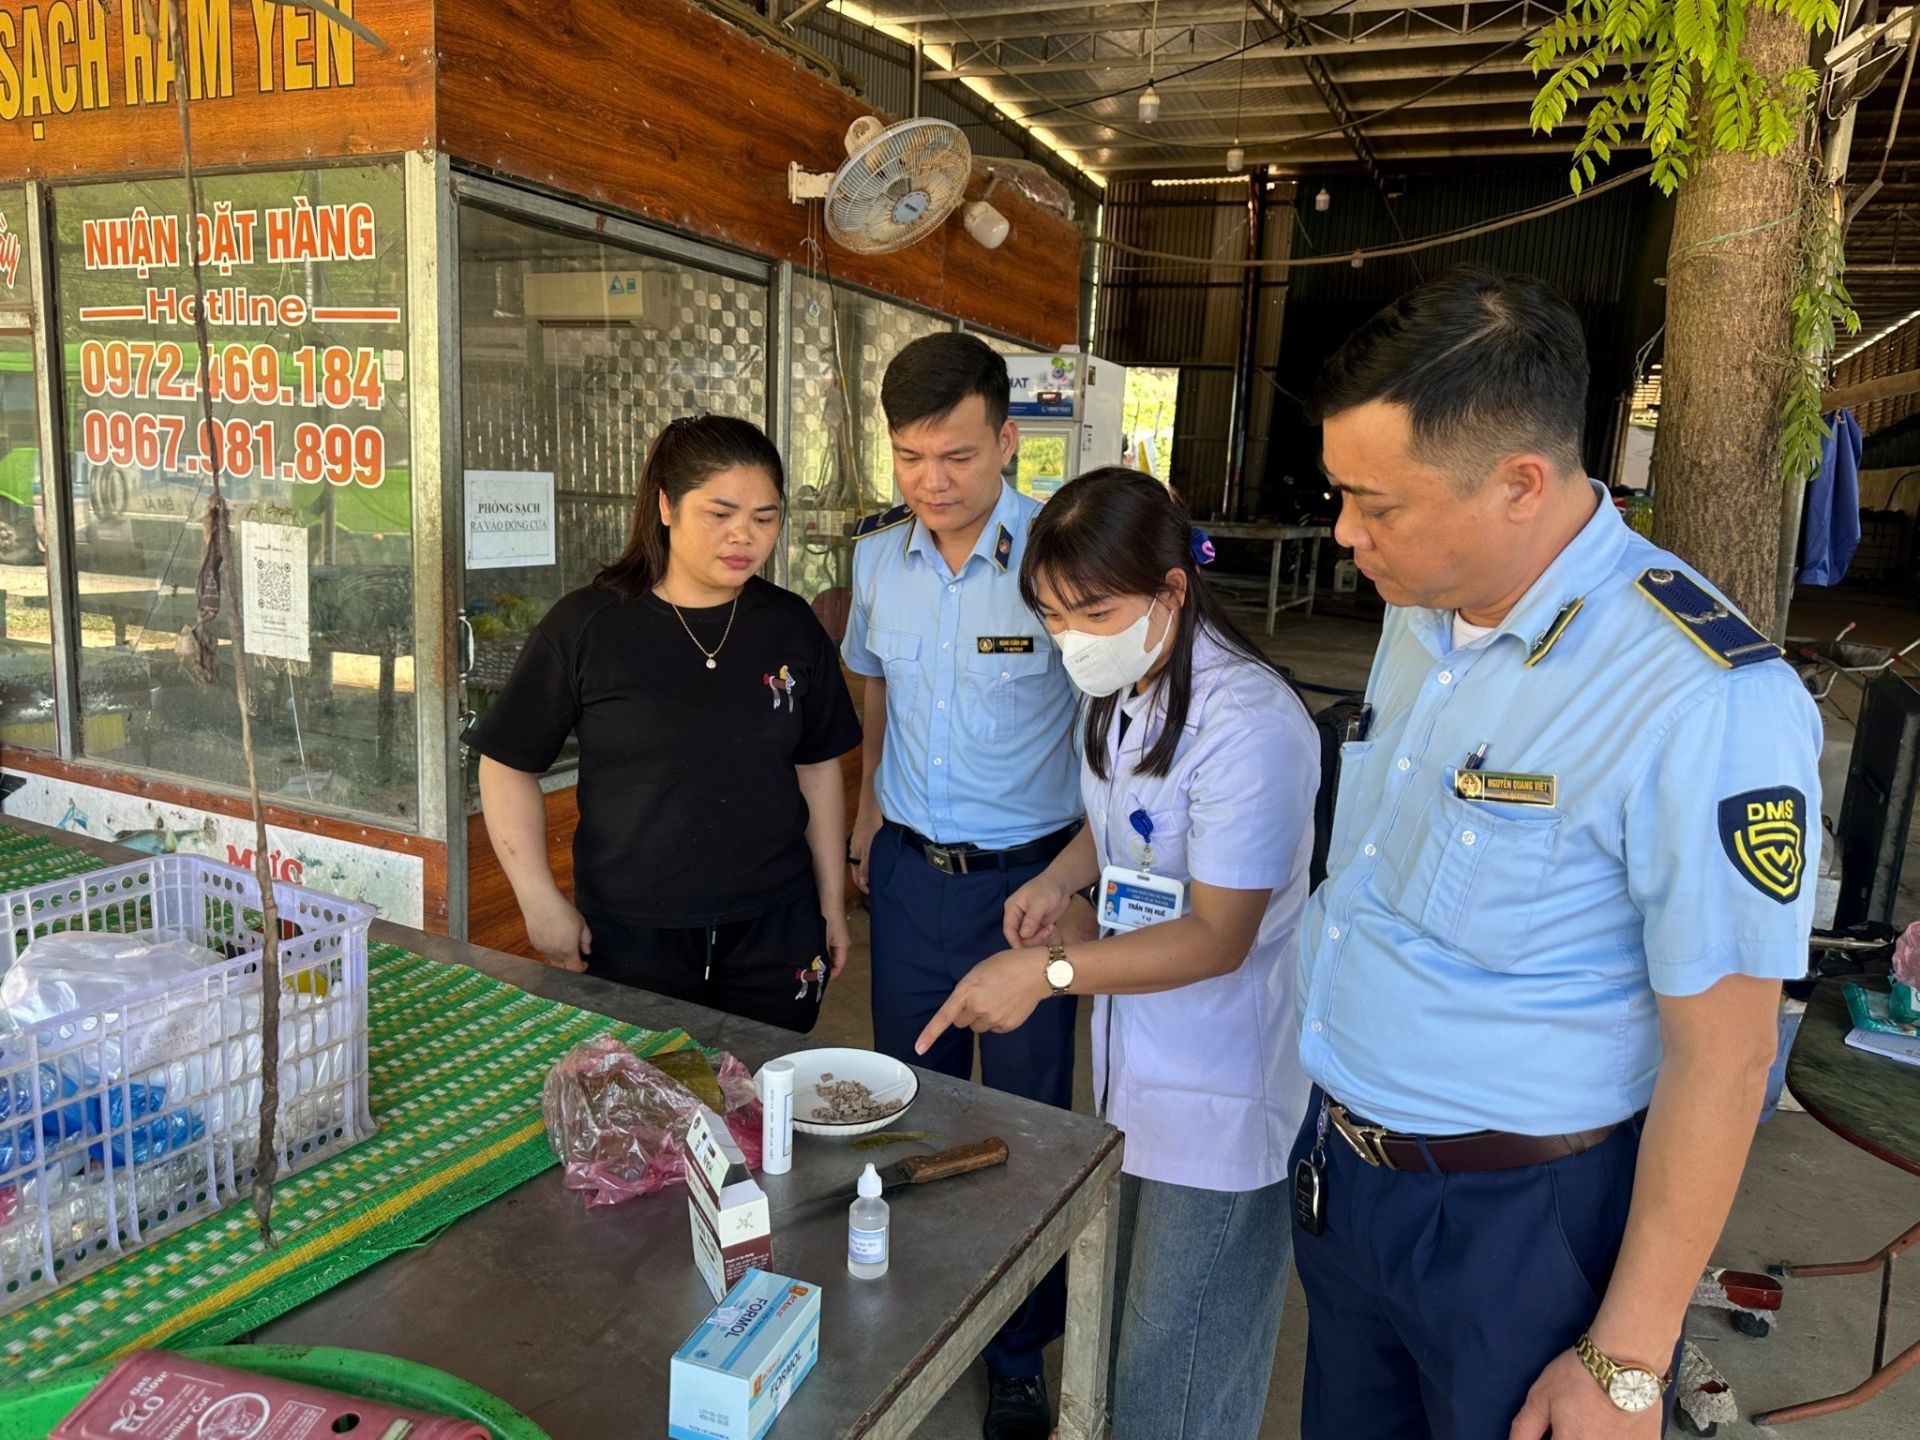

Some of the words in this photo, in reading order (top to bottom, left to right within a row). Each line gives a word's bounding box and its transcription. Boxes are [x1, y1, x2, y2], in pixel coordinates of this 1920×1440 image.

[0, 0, 111, 141] SẠCH
[83, 206, 180, 279] NHẬN
[186, 201, 257, 276] ĐẶT
[265, 196, 376, 263] HÀNG
[146, 287, 308, 326] Hotline
[80, 340, 385, 411] 0972.469.184
[83, 409, 386, 489] 0967.981.899
[471, 521, 484, 531] RA
[484, 518, 504, 530] VÀO
[477, 499, 513, 514] PHÒNG
[515, 502, 540, 516] SẠCH
[1746, 798, 1794, 821] DMS
[724, 1297, 769, 1339] FORMOL
